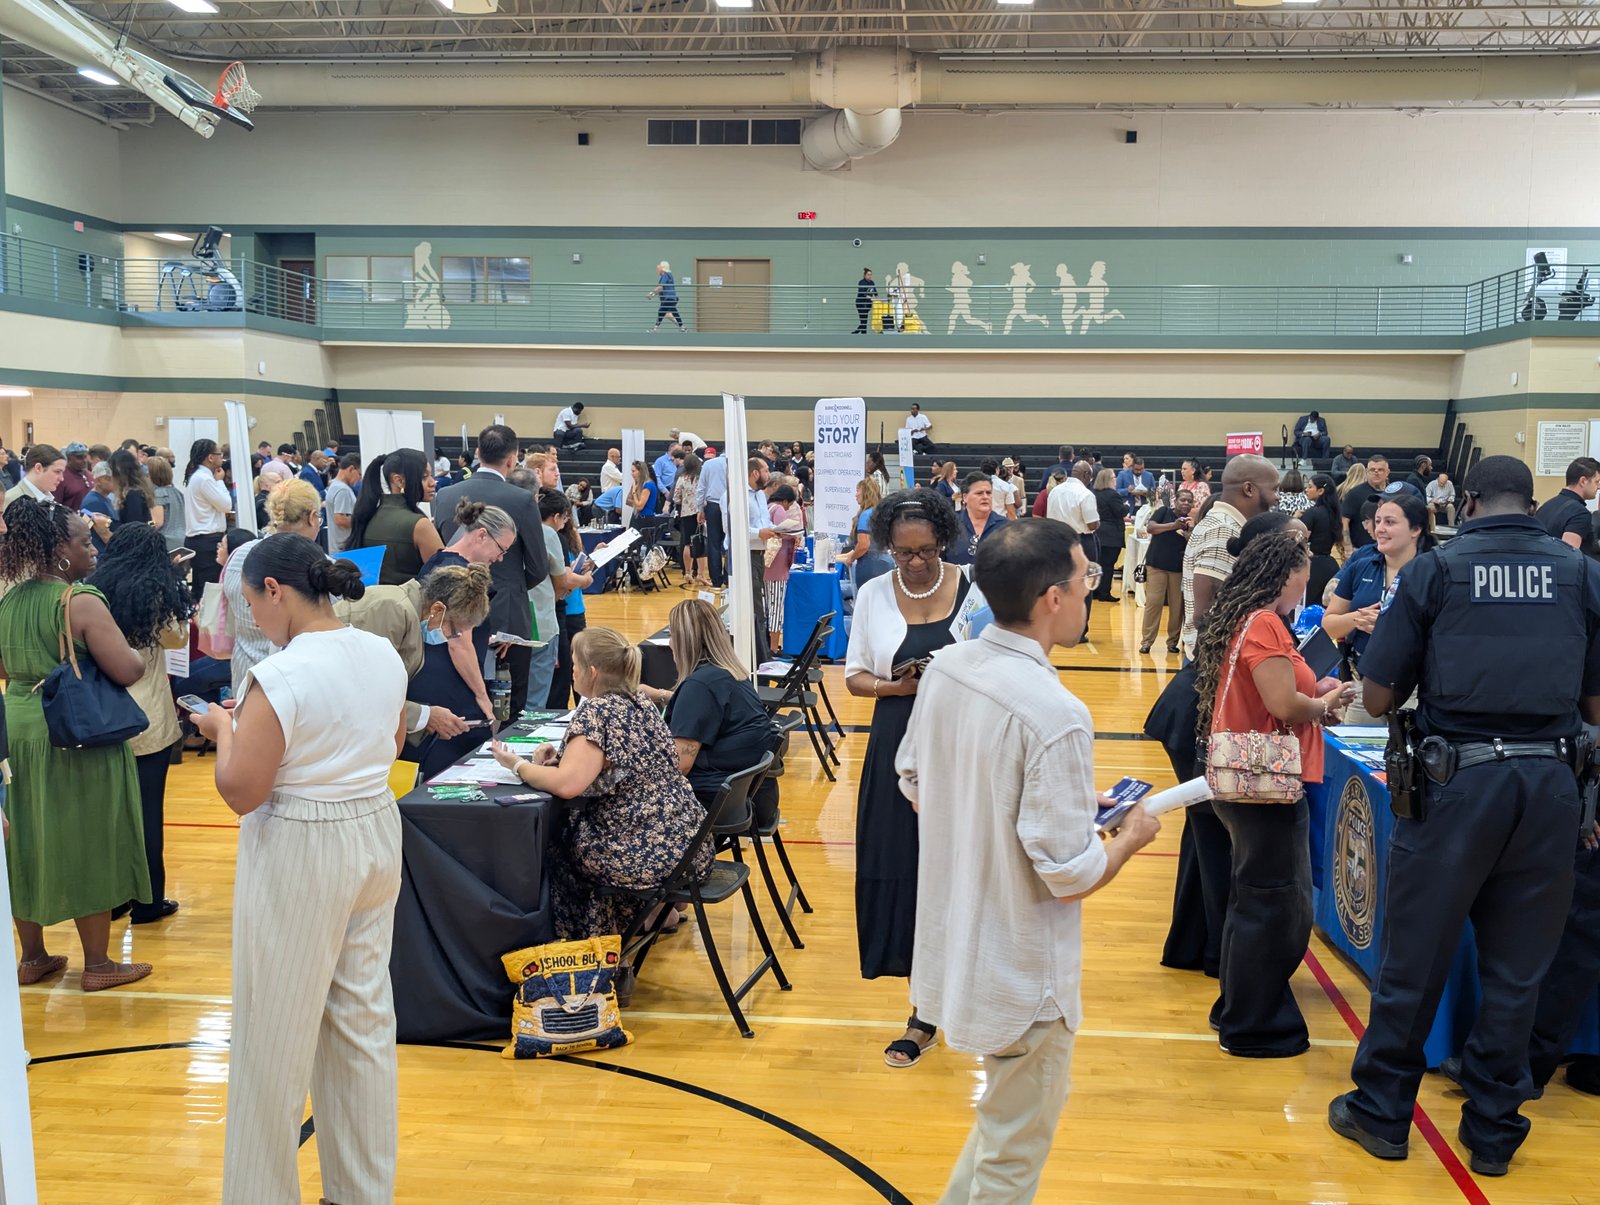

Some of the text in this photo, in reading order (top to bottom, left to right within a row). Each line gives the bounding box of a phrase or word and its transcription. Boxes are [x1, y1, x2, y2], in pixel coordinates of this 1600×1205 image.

[817, 413, 860, 425] BUILD YOUR
[818, 426, 860, 444] STORY
[837, 469, 862, 477] OPERATORS
[824, 486, 851, 494] SUPERVISORS
[825, 503, 850, 512] PIPEFITTERS
[1474, 565, 1553, 598] POLICE
